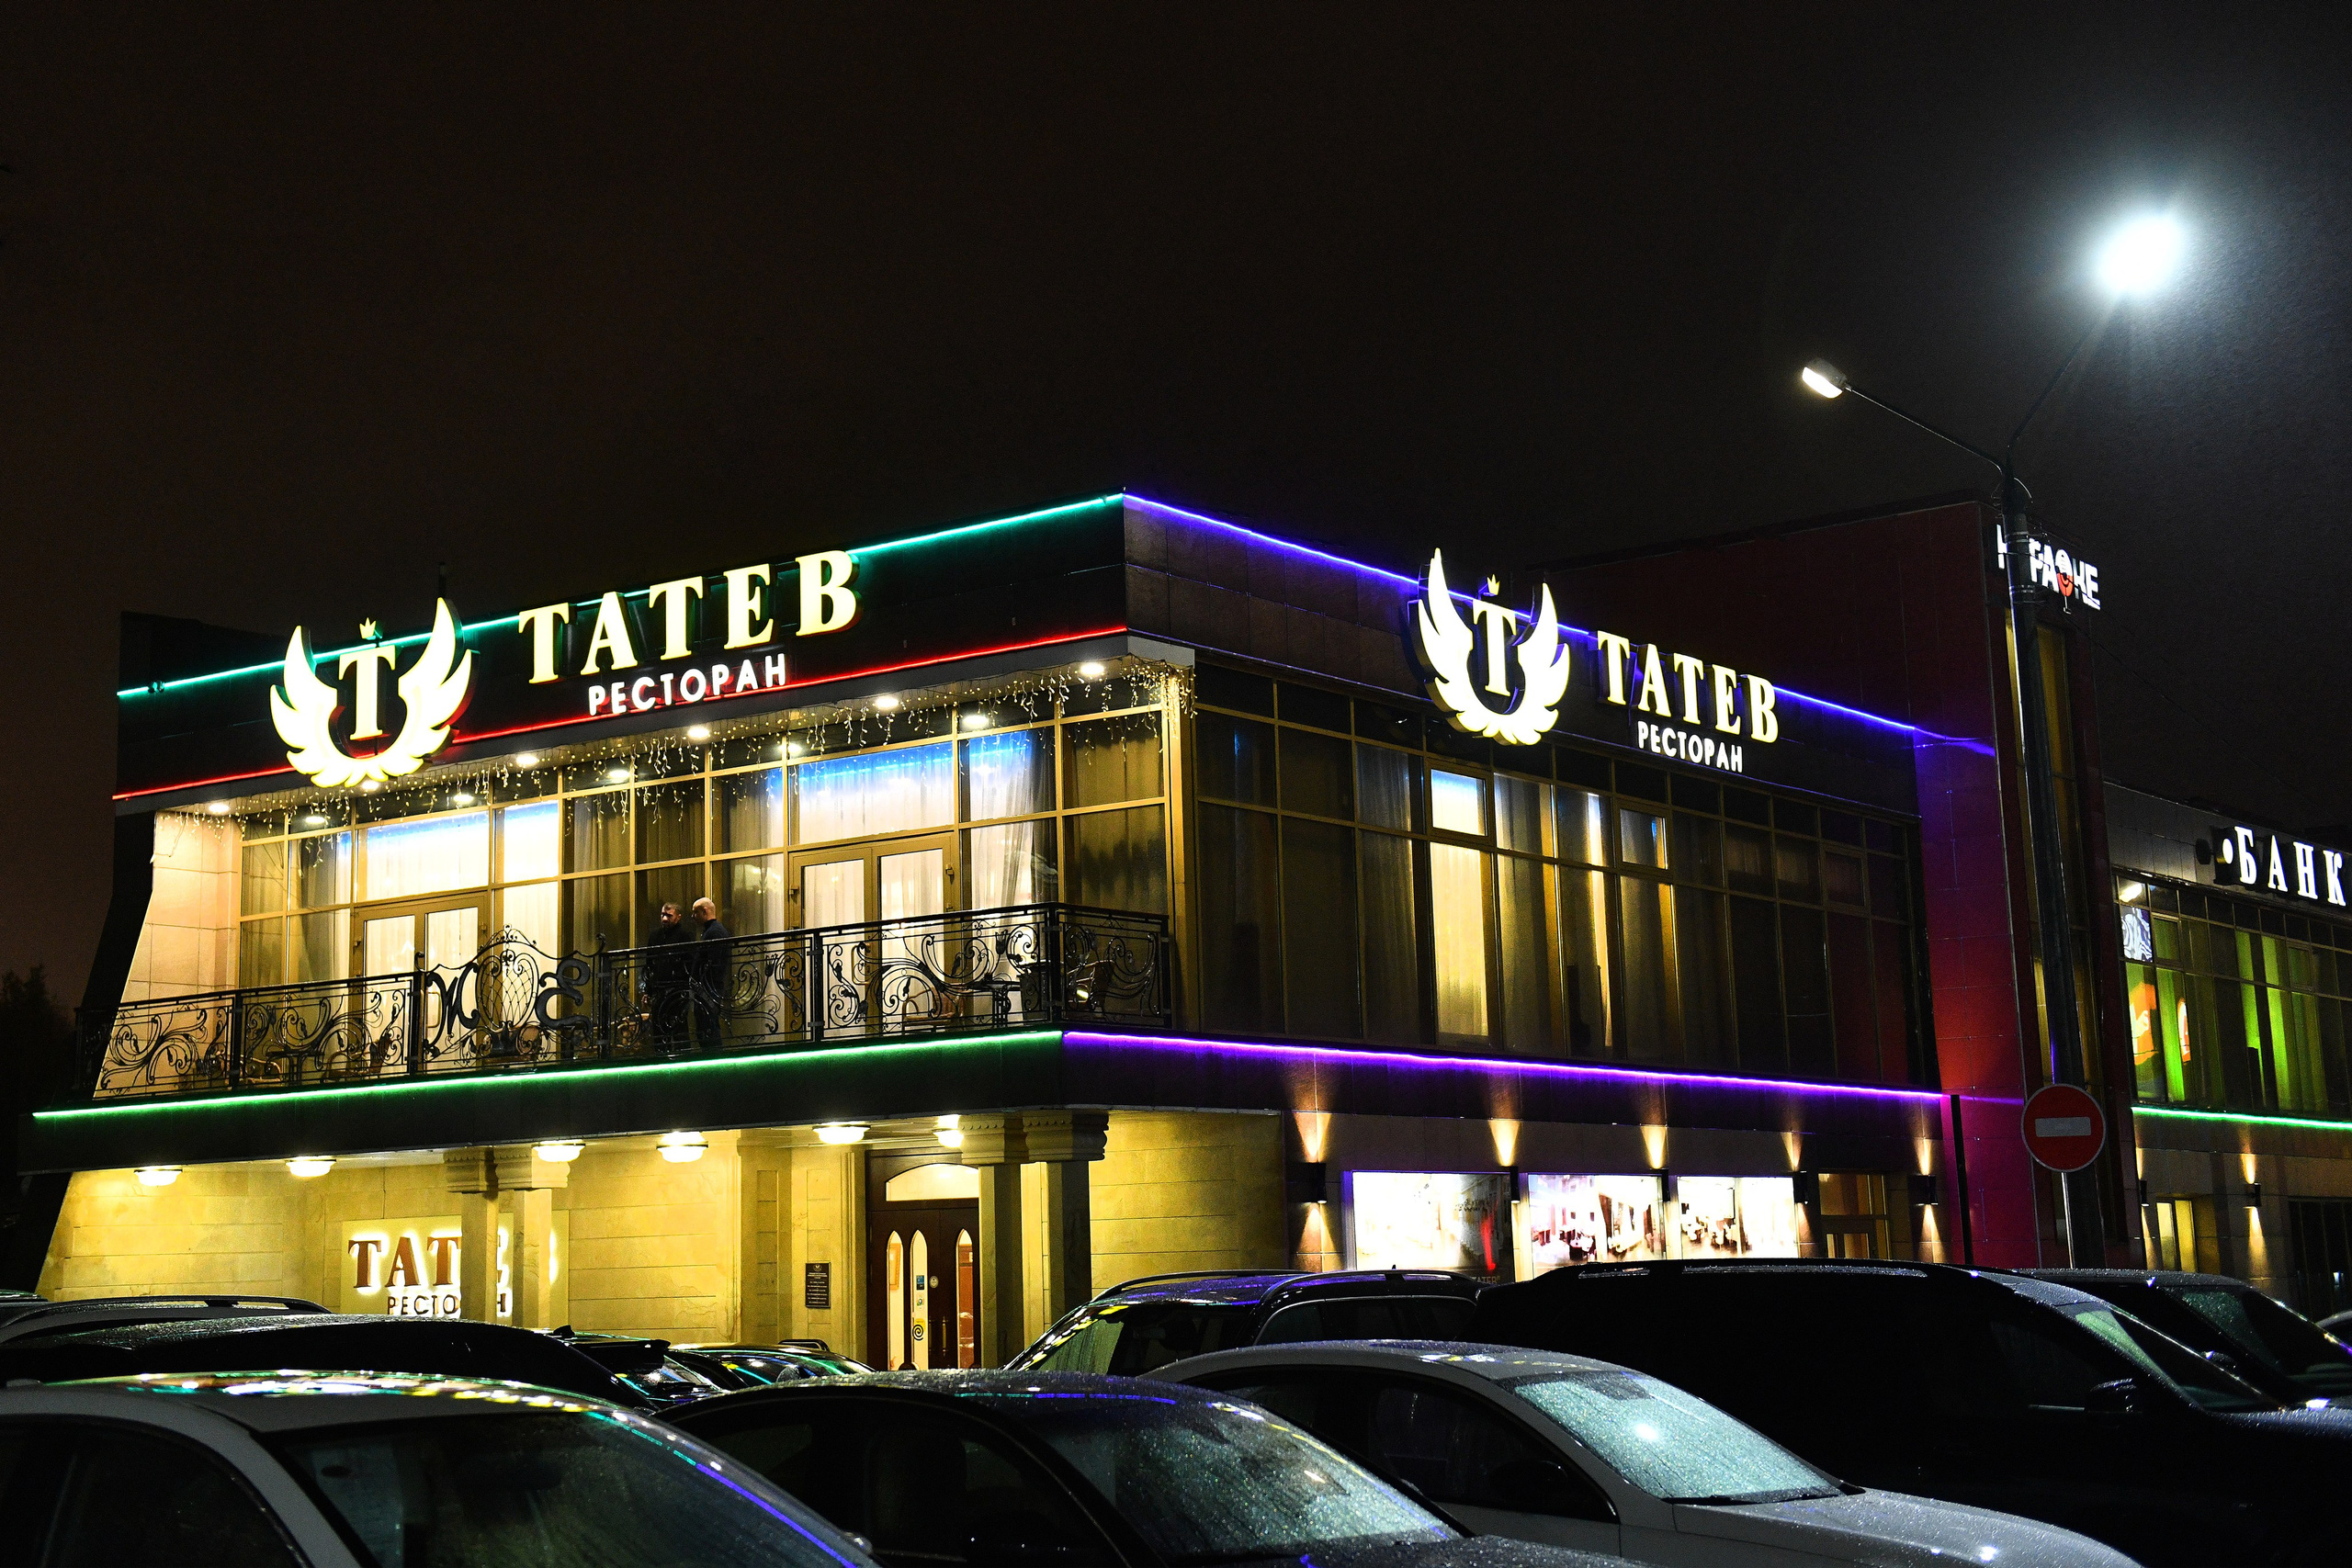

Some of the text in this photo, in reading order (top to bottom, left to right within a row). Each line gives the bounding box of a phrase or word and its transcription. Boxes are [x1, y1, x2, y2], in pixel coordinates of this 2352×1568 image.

[1996, 525, 2101, 611] РАОКЕ
[518, 550, 859, 684] ТАТЕВ
[588, 653, 786, 716] РЕСТОРАН
[1597, 630, 1779, 744] ТАТЕВ
[1637, 720, 1744, 773] РЕСТОРАН
[2233, 826, 2346, 907] БАНК
[348, 1235, 503, 1289] ТАТ
[387, 1292, 507, 1315] РЕСТОН
